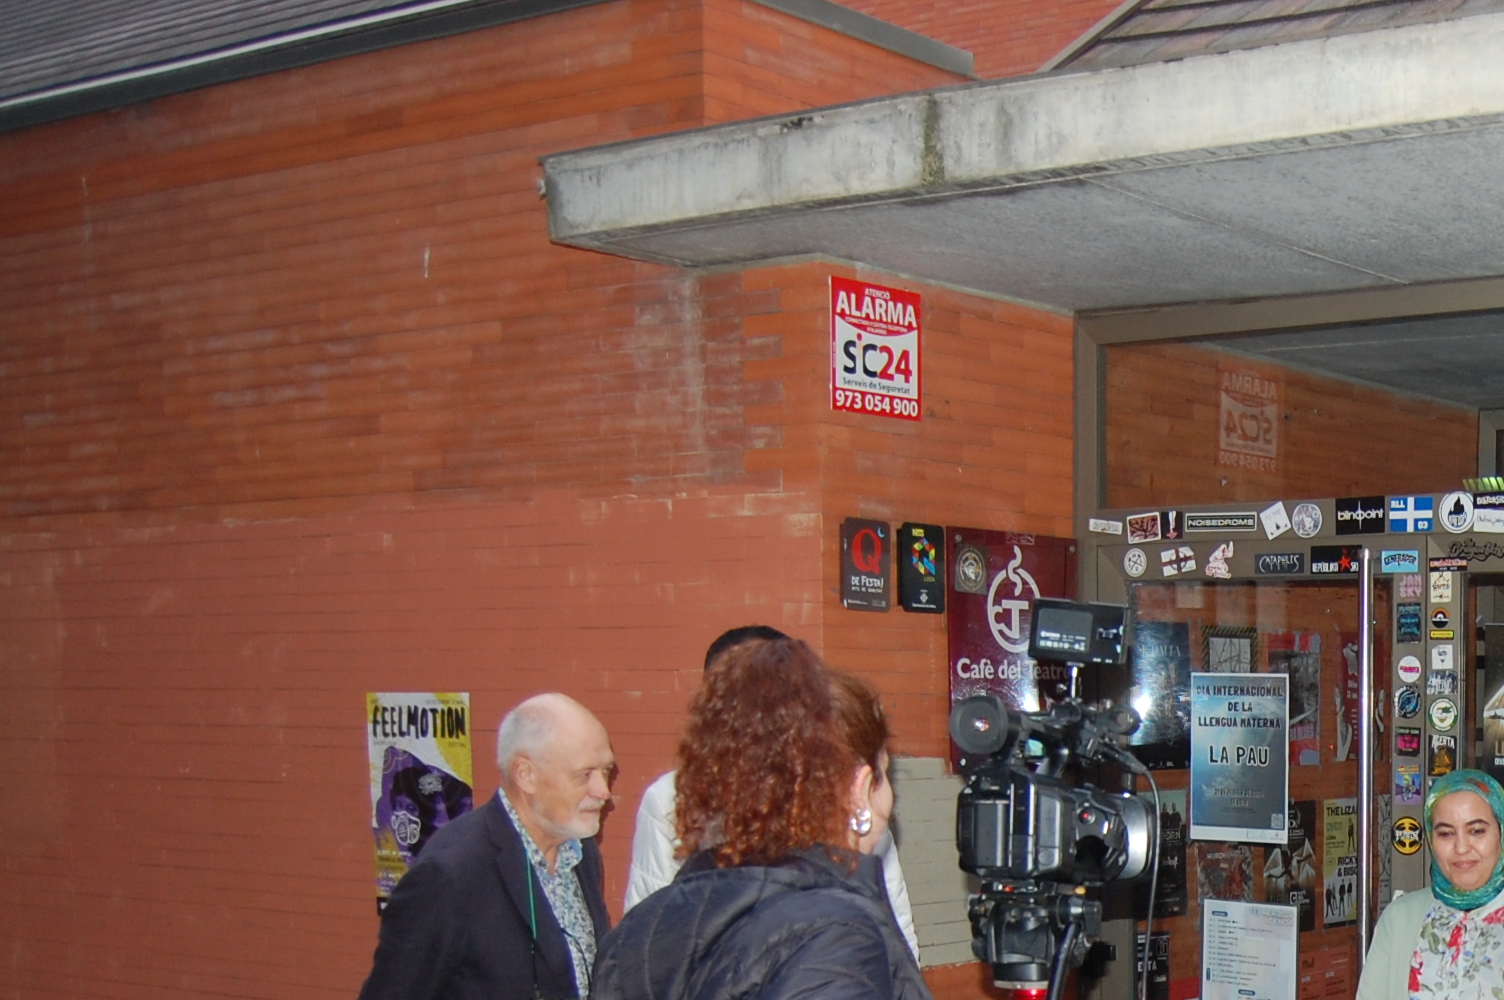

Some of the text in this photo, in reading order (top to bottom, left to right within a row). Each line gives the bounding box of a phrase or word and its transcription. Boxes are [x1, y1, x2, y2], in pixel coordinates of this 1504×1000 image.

[836, 290, 918, 328] ALARMA
[869, 381, 877, 389] de
[836, 390, 918, 417] 973 054 900
[957, 658, 994, 679] Cafè
[998, 658, 1022, 679] del
[1213, 686, 1283, 697] INTERNACIONAL
[1228, 702, 1252, 712] DE LA
[372, 705, 467, 739] FEELMOTION
[1198, 717, 1281, 728] LLENGUA MATERNA
[1210, 745, 1269, 766] LA PAU
